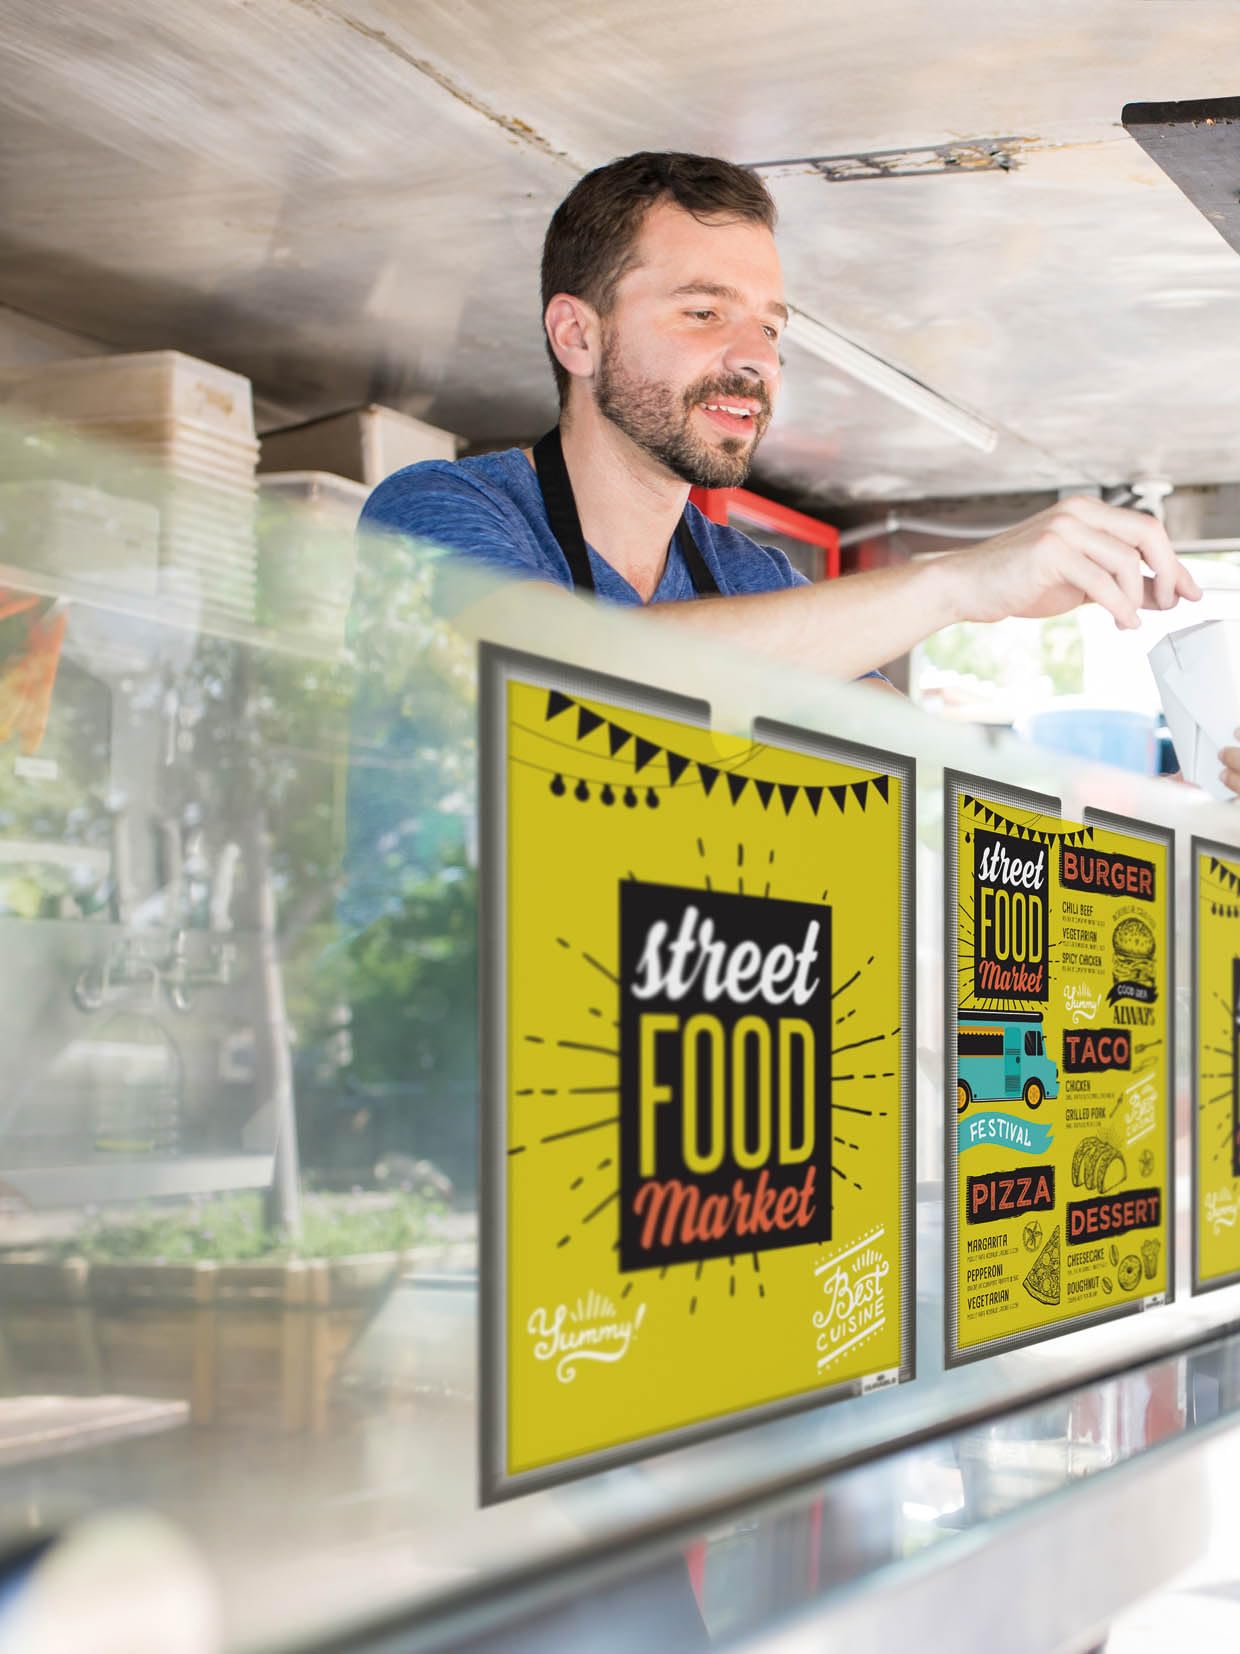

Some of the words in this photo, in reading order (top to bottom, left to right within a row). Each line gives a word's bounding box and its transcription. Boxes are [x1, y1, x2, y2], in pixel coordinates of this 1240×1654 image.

[978, 841, 1045, 890] street
[1063, 852, 1153, 896] BURGER
[1062, 901, 1079, 915] CHILI
[1080, 904, 1094, 917] BEEF
[980, 887, 1043, 963] FOOD
[1062, 927, 1098, 942] VEGETARIAN
[631, 906, 820, 1005] street
[1062, 952, 1078, 965] SPICY
[1078, 954, 1102, 967] CHICKEN
[978, 960, 1044, 993] Market
[1113, 1004, 1156, 1026] ALWAYS
[1065, 1036, 1129, 1065] TACO
[640, 1013, 815, 1178] FOOD
[1065, 1080, 1091, 1092] CHICKEN
[1065, 1108, 1090, 1121] GRILLED
[1091, 1107, 1106, 1119] PORK
[969, 1118, 1032, 1147] FESTIVAL
[633, 1165, 817, 1250] Market
[972, 1175, 1051, 1214] PIZZA
[1071, 1196, 1160, 1236] DESSERT
[967, 1234, 1008, 1254] MARGARITA
[1067, 1248, 1105, 1268] CHEESECAKE
[967, 1264, 1003, 1283] PEPPERONI
[1067, 1276, 1100, 1296] DOUGHNUT
[812, 1259, 890, 1329] Best
[967, 1289, 1010, 1310] VEGETARIAN
[816, 1296, 885, 1351] CUISINE
[527, 1301, 647, 1384] Yummy!
